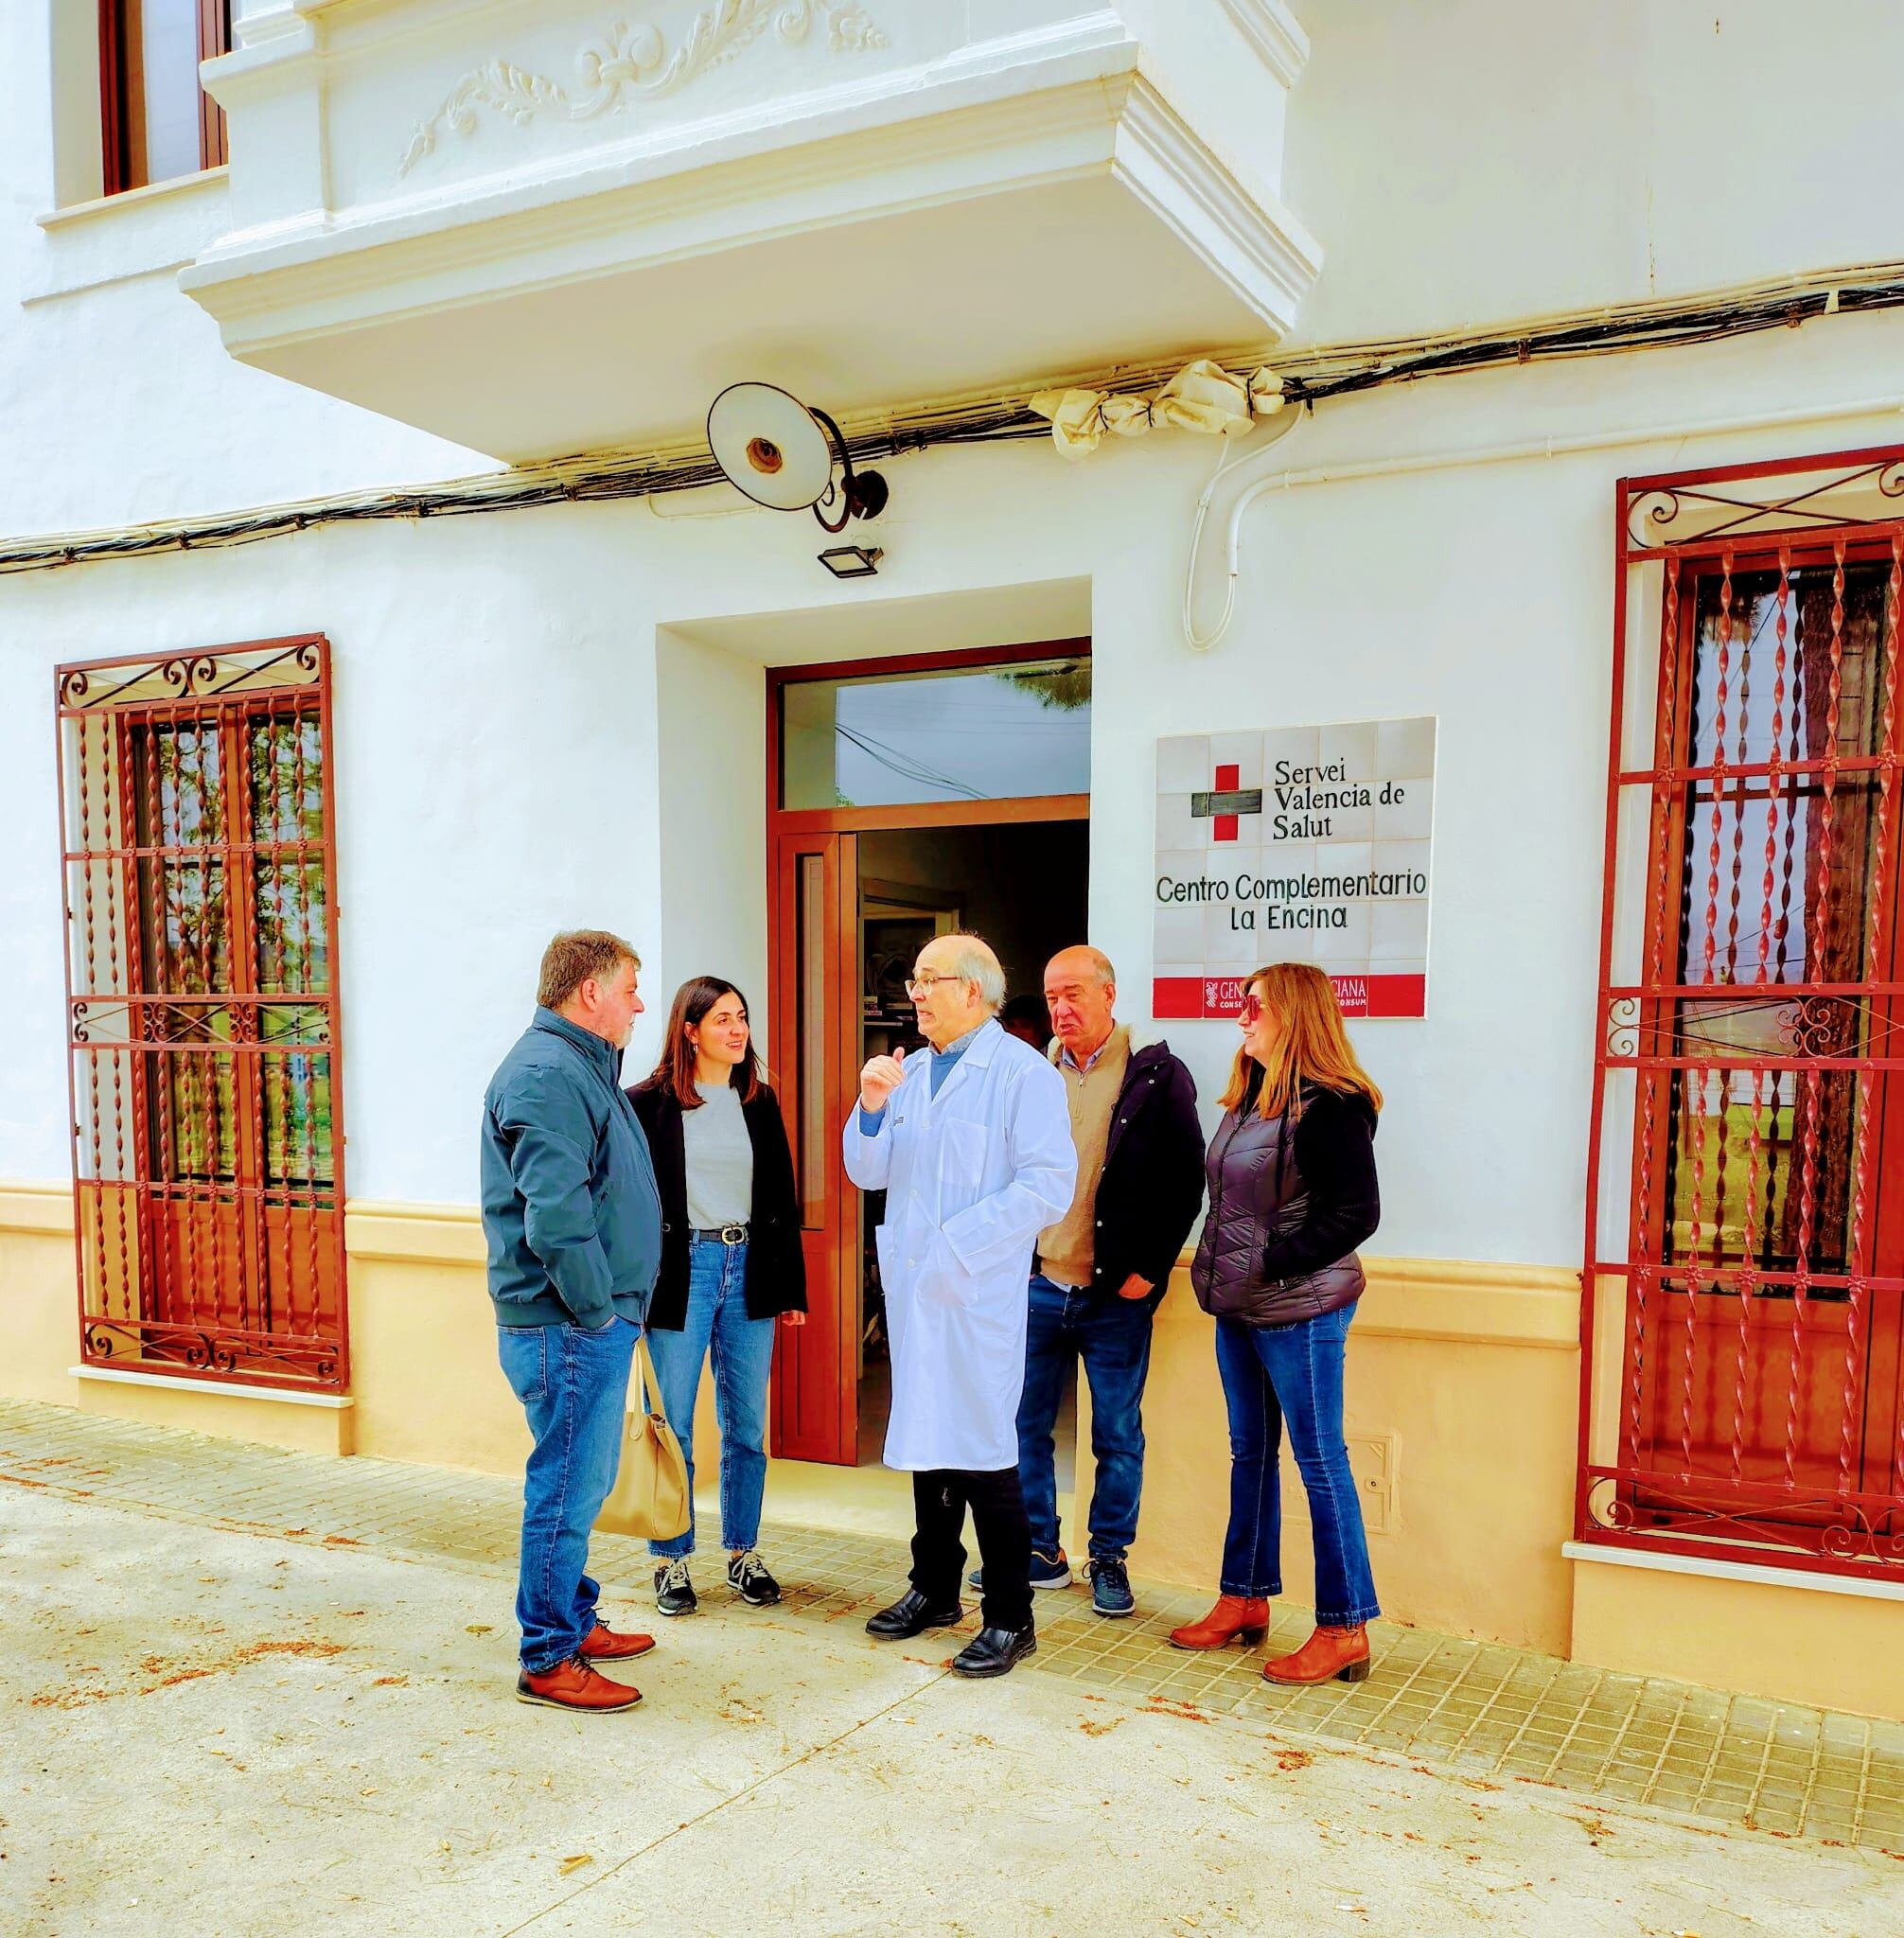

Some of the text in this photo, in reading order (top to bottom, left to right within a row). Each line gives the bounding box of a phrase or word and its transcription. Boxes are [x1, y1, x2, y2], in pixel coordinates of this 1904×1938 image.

[1275, 757, 1346, 785] Servei
[1274, 782, 1405, 811] Valencia de
[1273, 814, 1332, 840] Salut
[1156, 868, 1426, 905] Centro Complementario
[1268, 905, 1348, 929] Encina
[1220, 981, 1242, 999] GEN
[1220, 1000, 1242, 1009] CONSE
